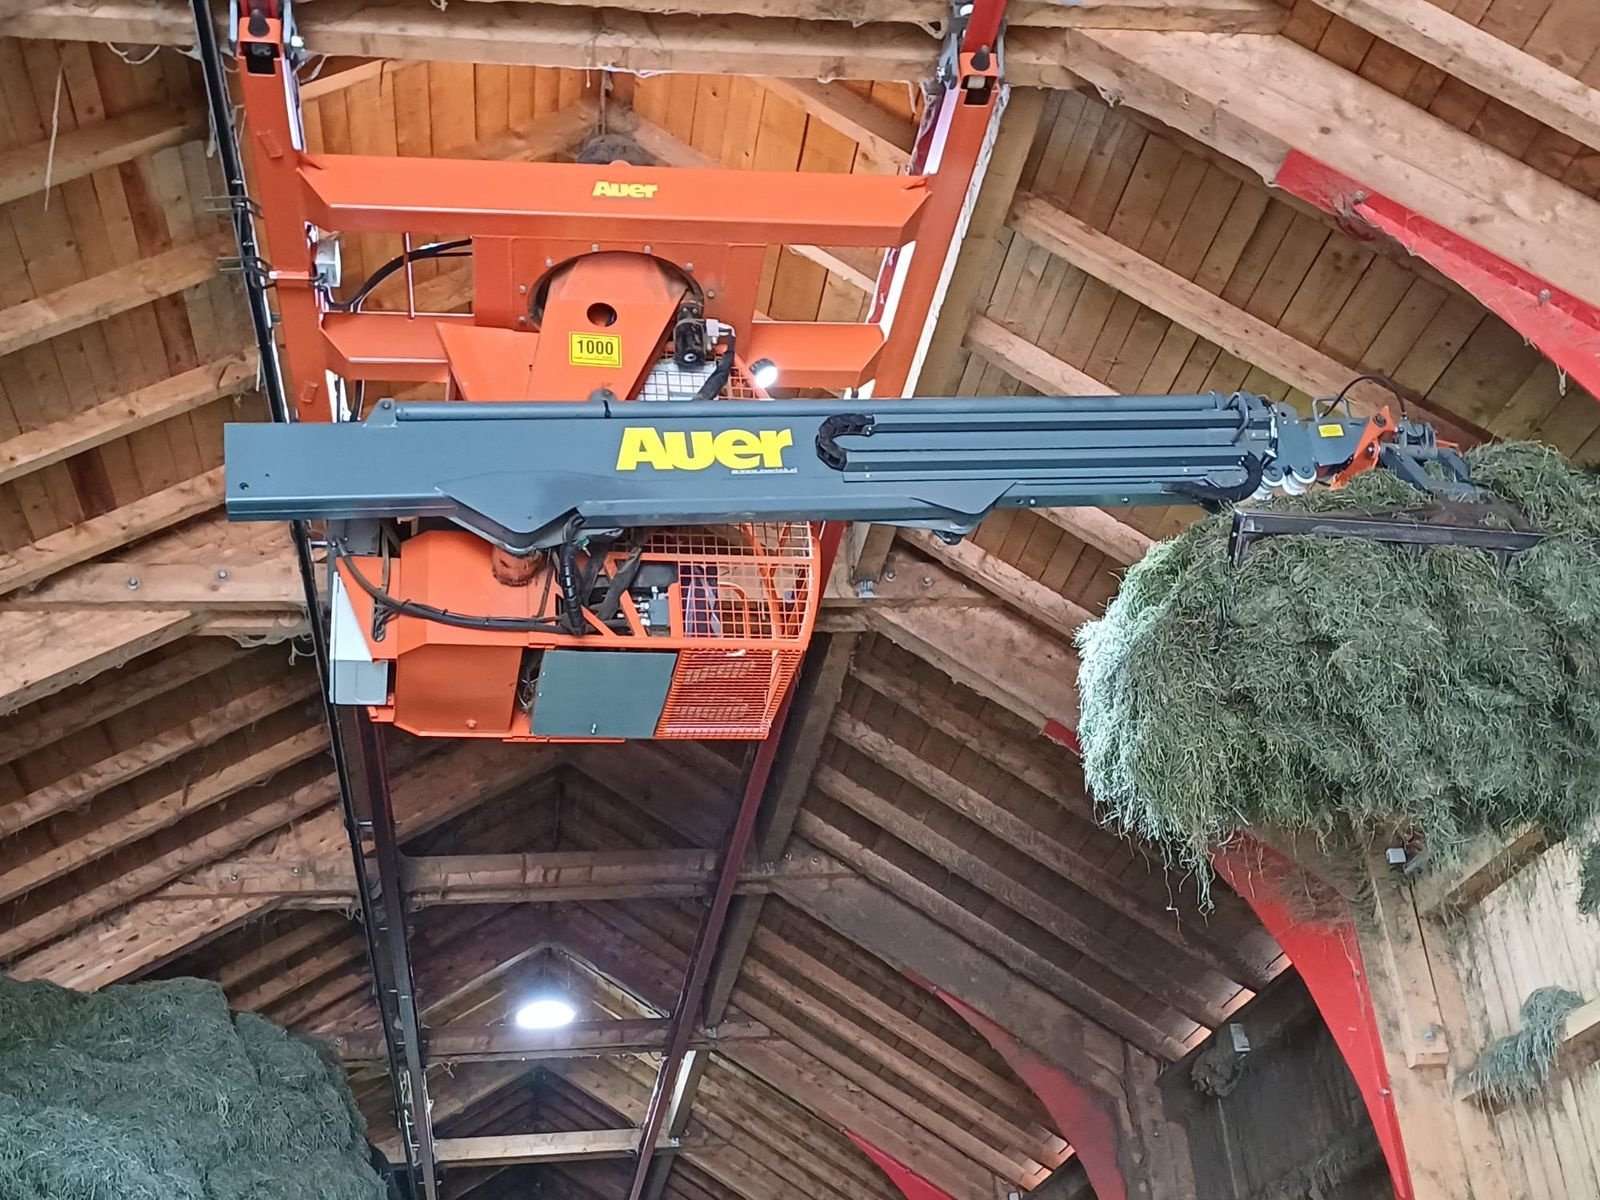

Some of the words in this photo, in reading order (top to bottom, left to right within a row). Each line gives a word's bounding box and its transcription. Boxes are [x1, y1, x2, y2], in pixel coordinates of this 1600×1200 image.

[592, 181, 658, 199] Auer
[577, 340, 614, 355] 1000
[615, 426, 793, 471] Auer
